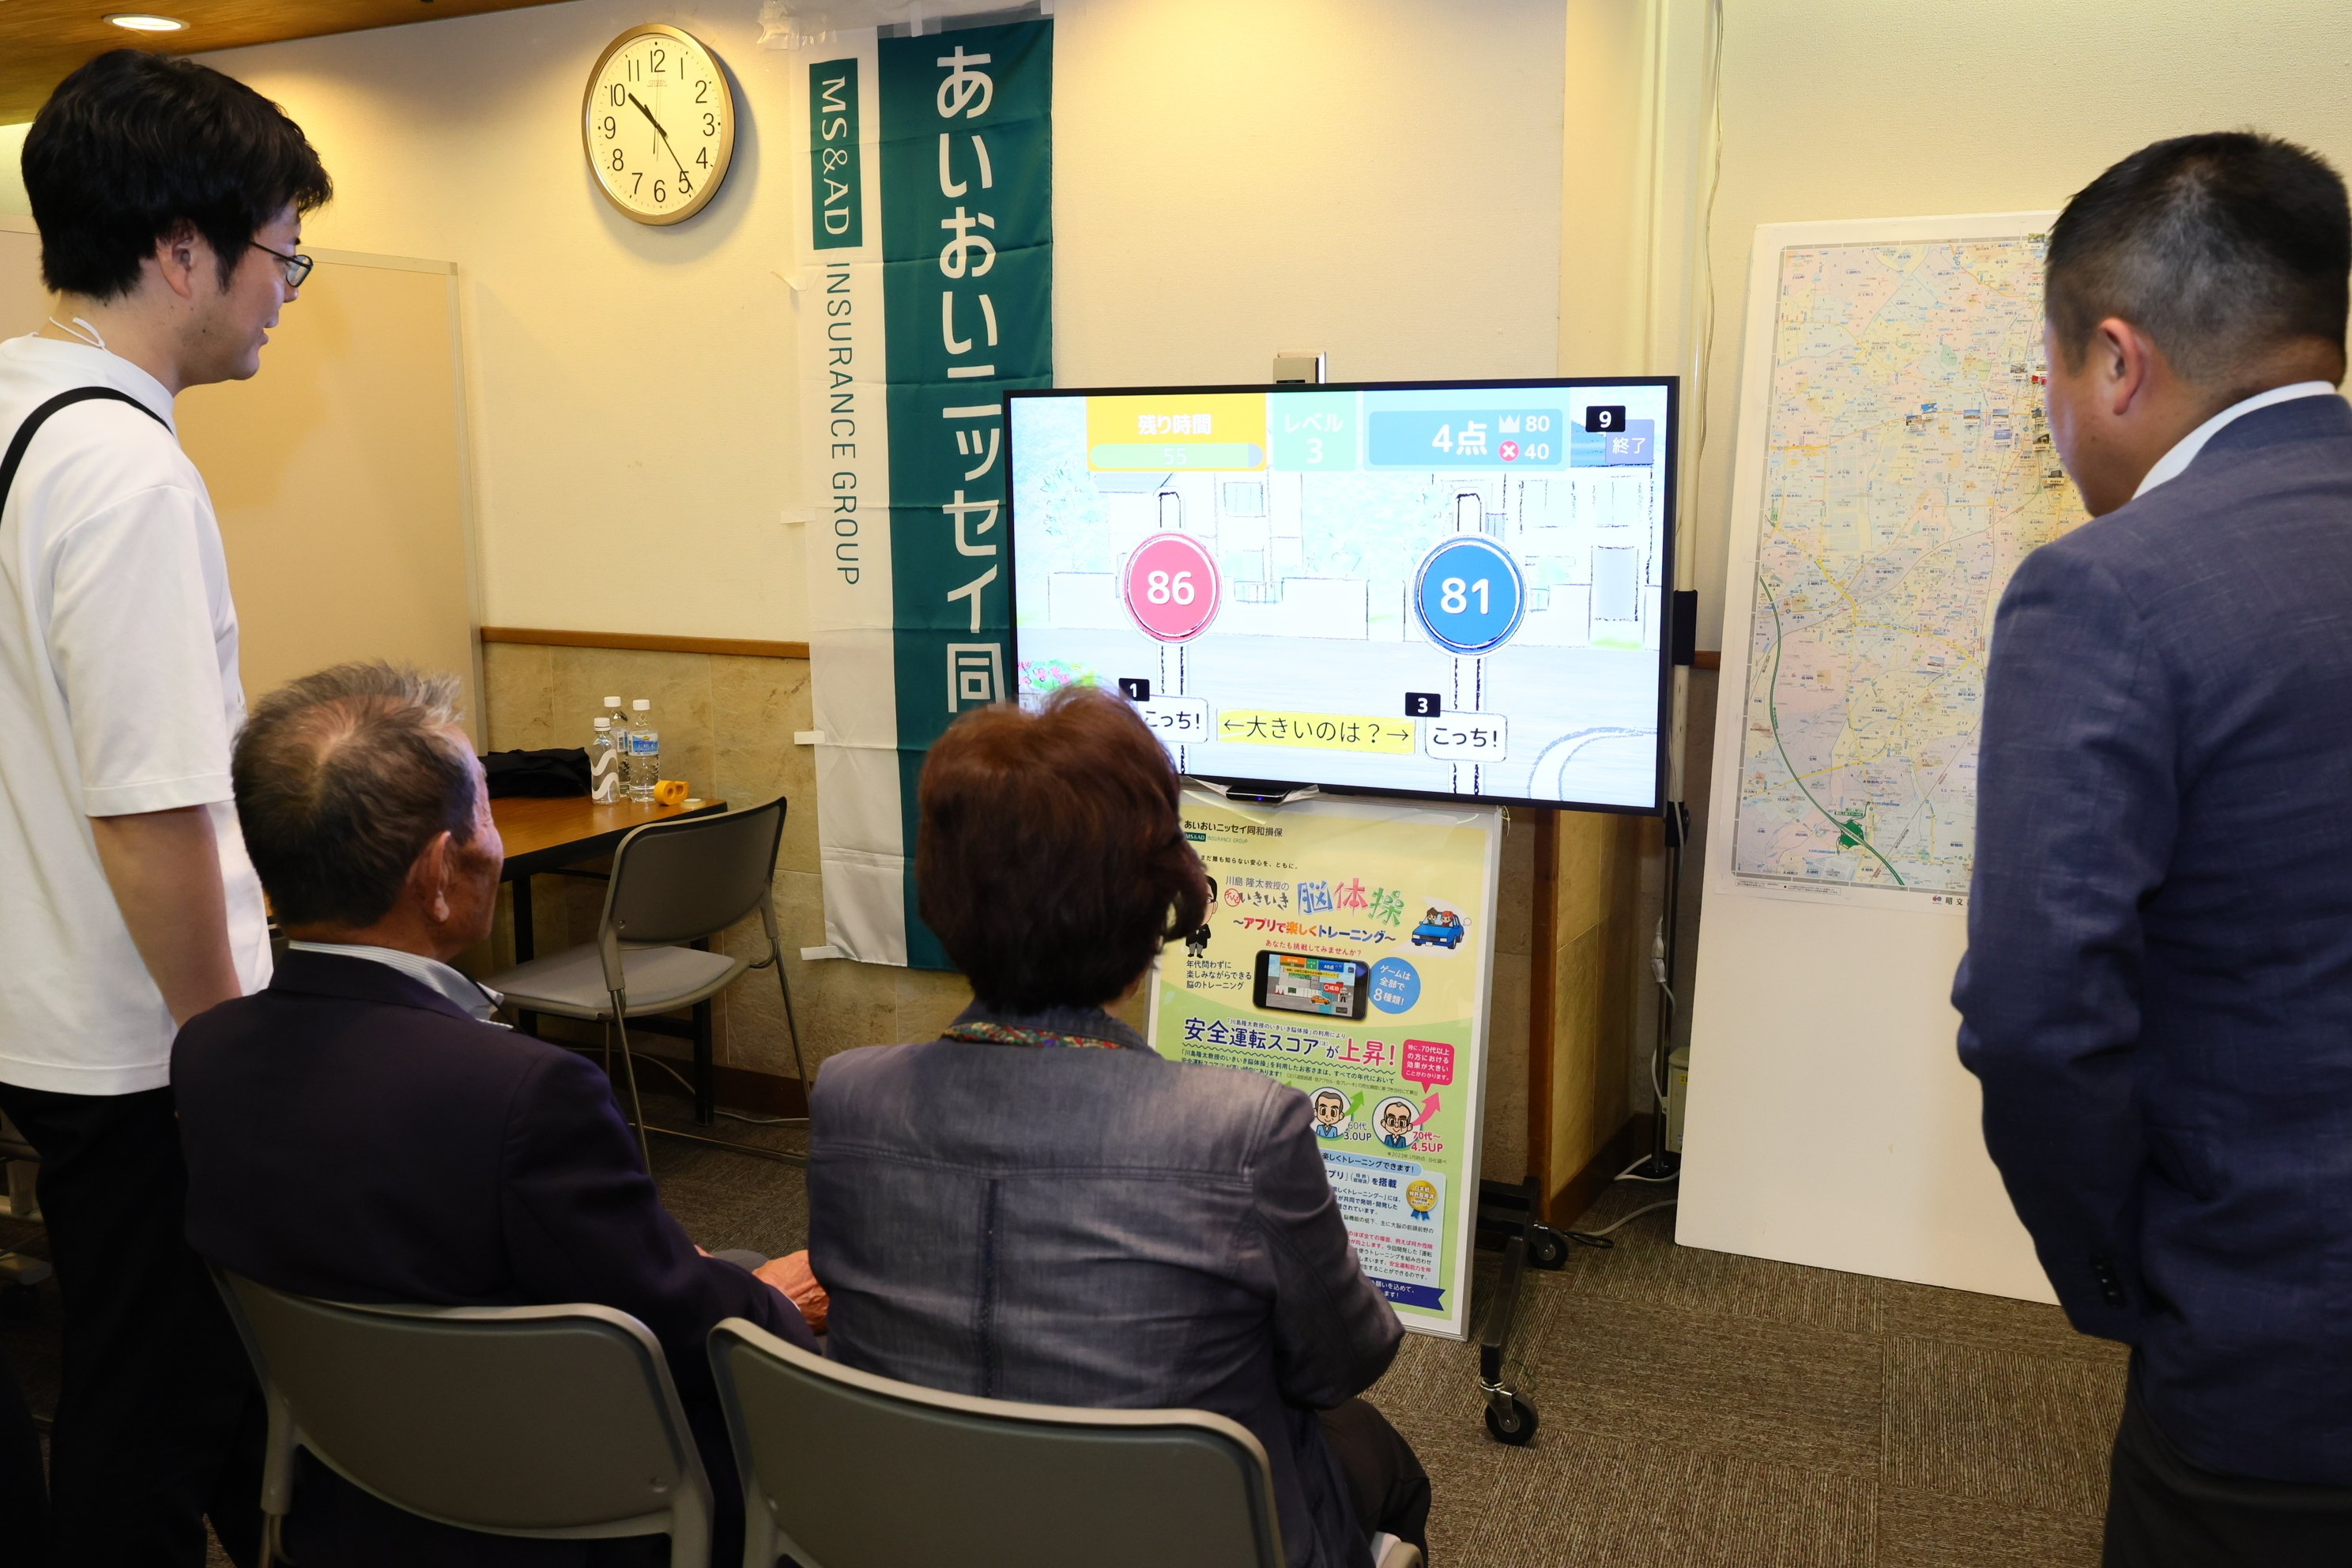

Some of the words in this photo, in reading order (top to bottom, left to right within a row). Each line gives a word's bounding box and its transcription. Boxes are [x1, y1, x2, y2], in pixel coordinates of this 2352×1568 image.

[650, 49, 665, 73] 12
[680, 57, 684, 80] 1
[610, 83, 625, 107] 10
[695, 80, 707, 104] 2
[604, 116, 616, 139] 9
[703, 113, 715, 136] 3
[612, 149, 624, 172] 8
[695, 147, 708, 169] 4
[821, 76, 850, 236] MS&AD
[631, 172, 643, 194] 7
[654, 179, 665, 202] 6
[678, 171, 691, 194] 5
[826, 263, 856, 459] INSURANCE
[937, 45, 1006, 713] あいおいニッセイ同
[1138, 414, 1212, 435] 残り時間
[1284, 413, 1343, 433] レベル
[1525, 415, 1550, 432] 80
[1599, 411, 1611, 428] 9
[1431, 420, 1487, 456] 4点
[1612, 437, 1646, 454] 終了
[1163, 448, 1189, 466] 55
[1306, 438, 1323, 464] 3
[1524, 443, 1550, 460] 40
[831, 472, 860, 585] GROUP
[1146, 571, 1196, 605] 86
[1440, 578, 1490, 615] 81
[1129, 683, 1137, 698] 1
[1417, 698, 1429, 714] 3
[1144, 710, 1200, 729] こっち!
[1433, 726, 1498, 748] こっち!
[1184, 820, 1283, 838] あいおいニッセイ同和損保
[1297, 877, 1404, 926] 脳体操
[1186, 960, 1231, 969] 年代問わずに
[1186, 971, 1252, 980] 楽しみながらできる
[1380, 964, 1412, 981] ゲームは
[1186, 980, 1244, 989] 脳のトレーニング
[1379, 976, 1405, 991] 全部で
[1407, 1061, 1449, 1072] 効果が大きい
[1344, 1132, 1372, 1141] 3.0UP
[1348, 1121, 1366, 1131] 60代
[1411, 1142, 1443, 1152] 4.5UP
